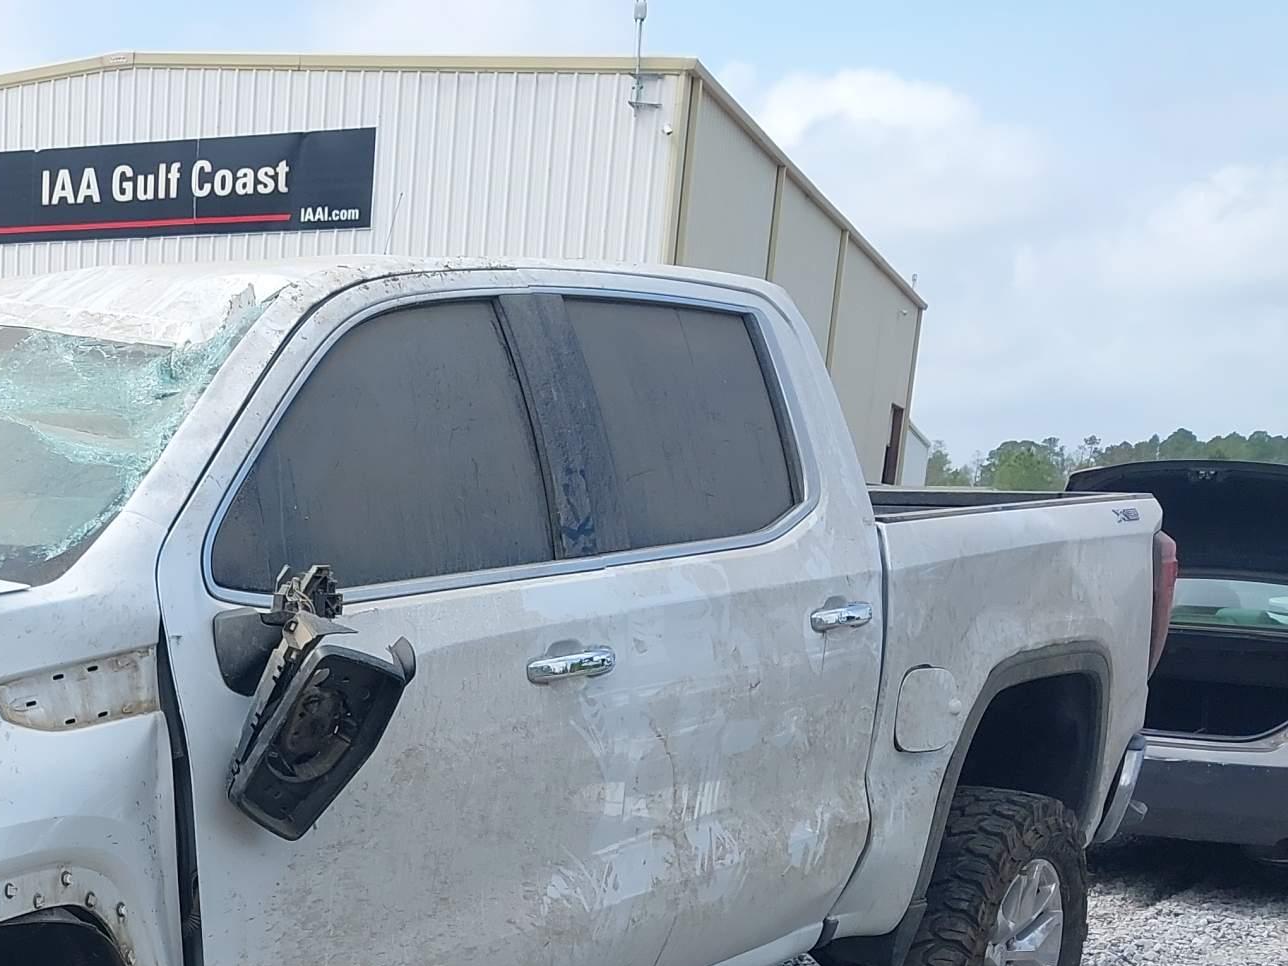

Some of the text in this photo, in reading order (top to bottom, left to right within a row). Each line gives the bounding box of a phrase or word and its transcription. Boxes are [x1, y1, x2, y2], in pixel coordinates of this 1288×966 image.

[41, 159, 290, 206] IAA Gulf Coast
[300, 205, 360, 223] IAAI.com
